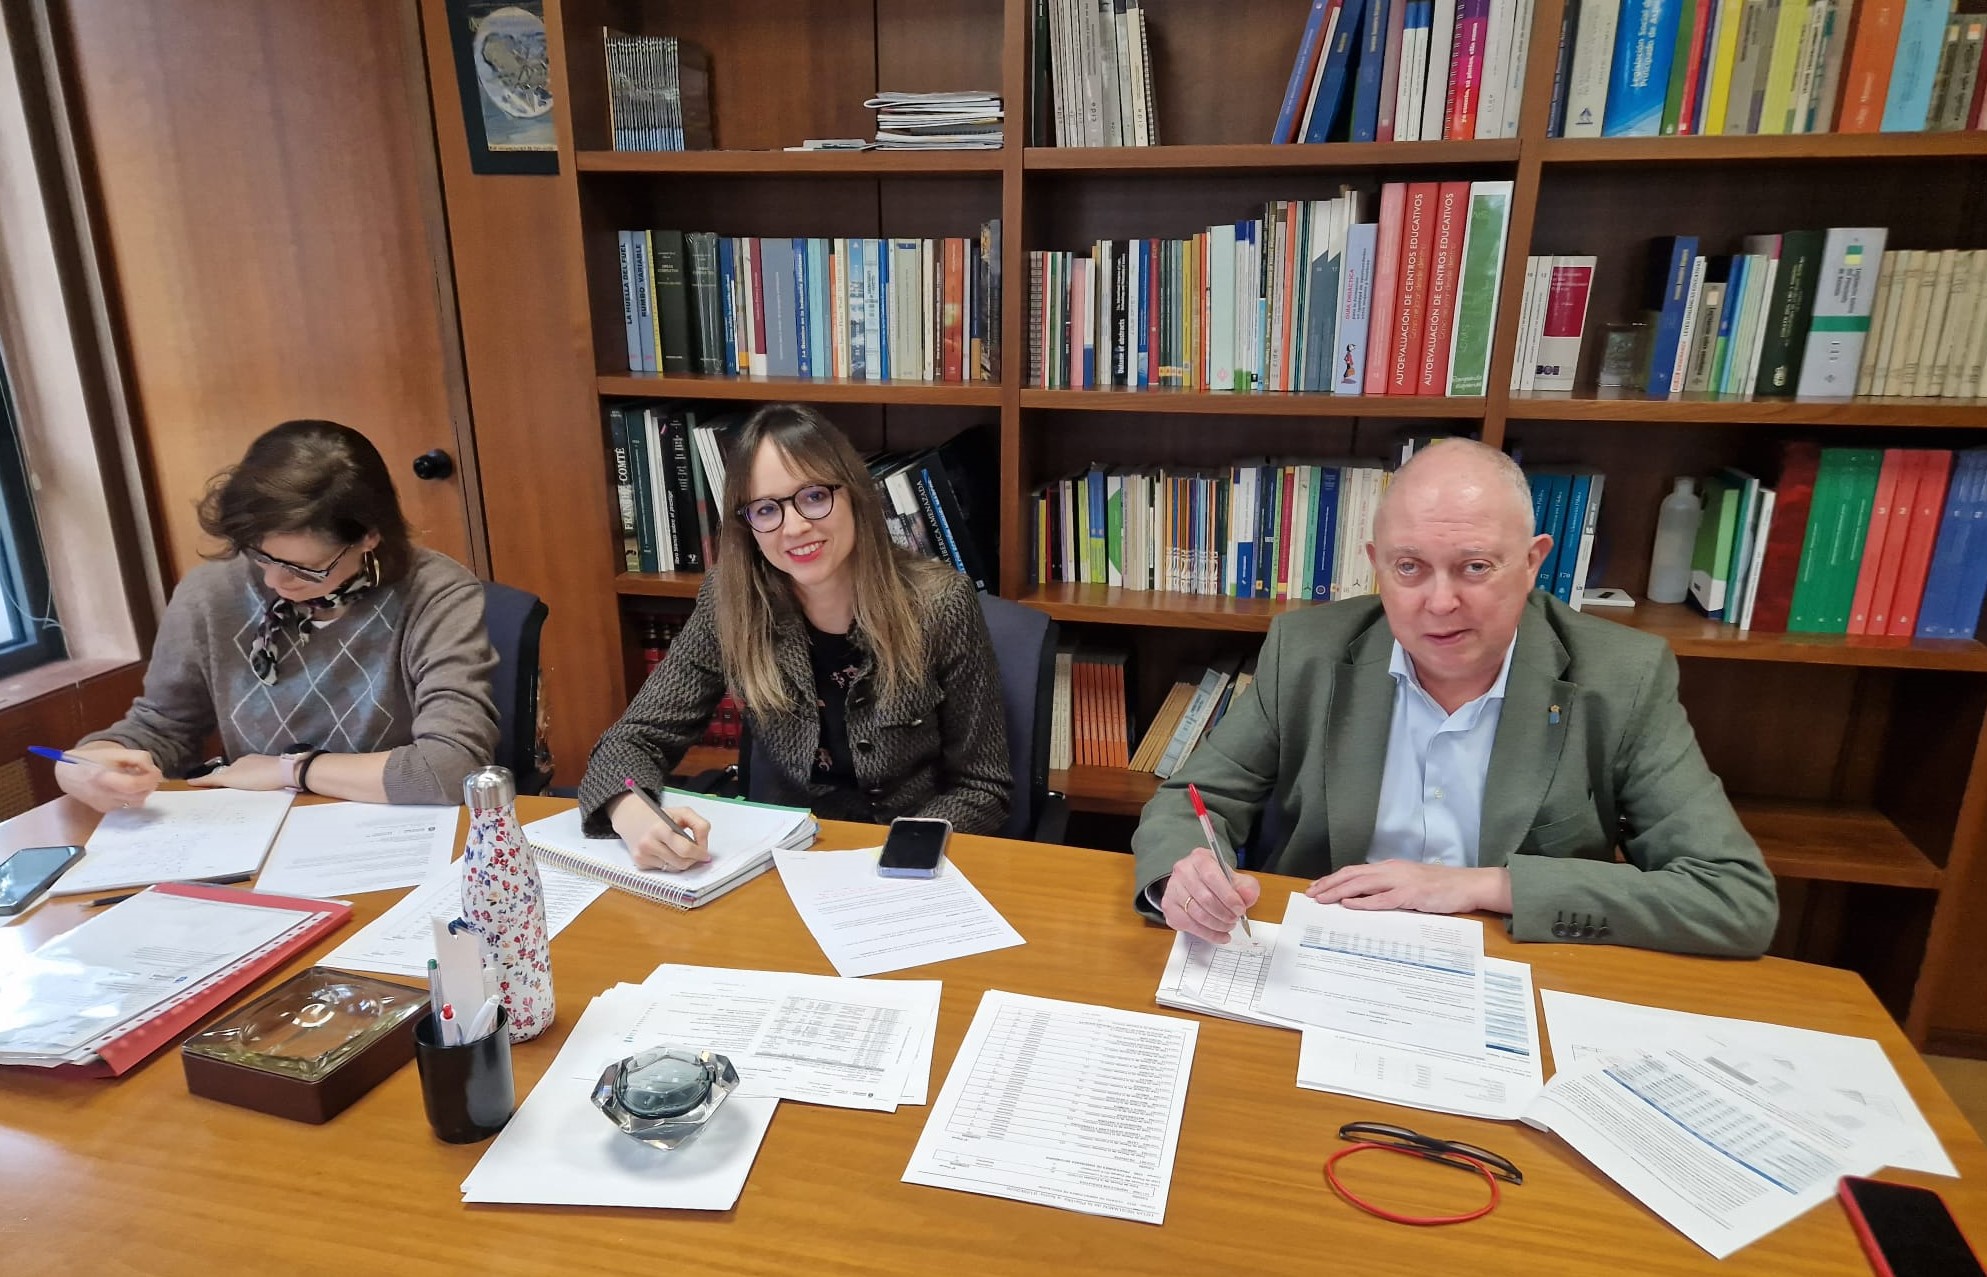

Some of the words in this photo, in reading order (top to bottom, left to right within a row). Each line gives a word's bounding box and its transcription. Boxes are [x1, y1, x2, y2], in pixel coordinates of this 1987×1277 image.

[1629, 39, 1645, 87] Legislación
[1637, 9, 1649, 36] Social
[1639, 39, 1655, 87] Principado
[1089, 102, 1097, 122] cide
[1410, 193, 1423, 249] EDUCATIVOS
[1440, 193, 1454, 249] EDUCATIVOS
[635, 243, 644, 283] VARIABLE
[1405, 251, 1417, 292] CENTROS
[1435, 251, 1447, 292] CENTROS
[623, 282, 632, 313] HUELLA
[639, 287, 647, 317] RUMBO
[1346, 269, 1355, 303] DIDÁCTICA
[1404, 294, 1412, 305] DE
[1433, 294, 1441, 305] DE
[626, 315, 633, 325] LA
[1117, 319, 1125, 345] abstracts
[1117, 353, 1125, 374] Volume
[1395, 308, 1410, 386] AUTOEVALUACIÓN
[1424, 308, 1440, 386] AUTOEVALUACIÓN
[1536, 365, 1560, 375] BOE
[914, 479, 938, 528] AMENAZADA
[932, 527, 949, 558] IBÉRICA
